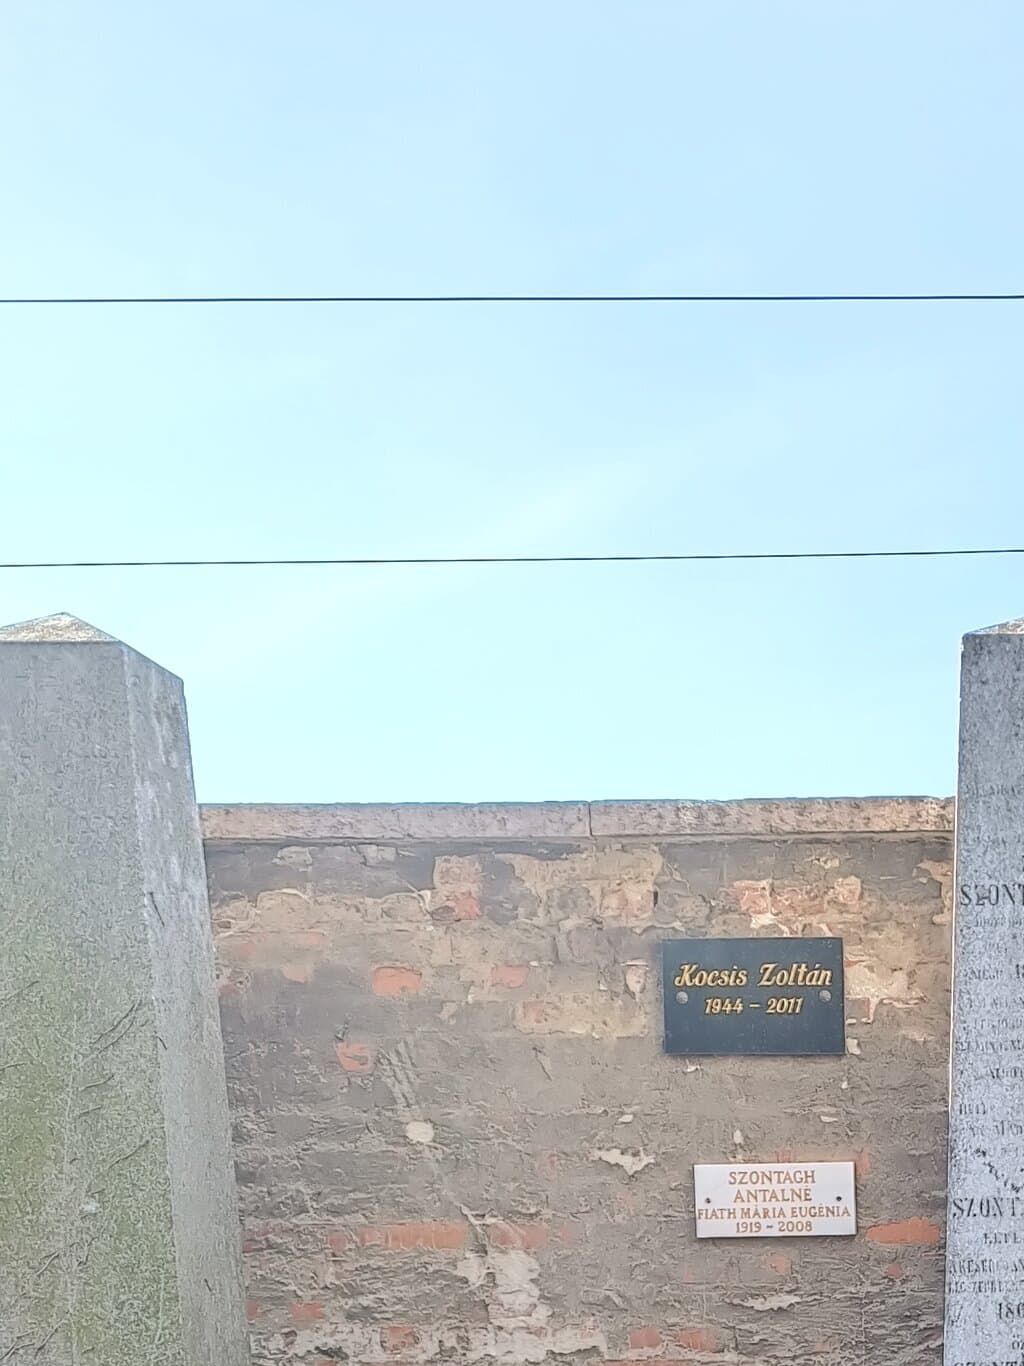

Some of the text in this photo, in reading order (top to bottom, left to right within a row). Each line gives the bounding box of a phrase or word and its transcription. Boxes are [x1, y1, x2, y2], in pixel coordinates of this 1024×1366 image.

[673, 962, 834, 987] Kocsis Zoltán
[704, 997, 744, 1015] 1944
[766, 997, 804, 1015] 2011
[728, 1170, 817, 1186] SZONTAGH
[733, 1186, 813, 1204] ANTALNÉ
[740, 1204, 788, 1220] MÁRIA
[790, 1203, 852, 1219] EUGÉNIA
[735, 1221, 763, 1234] 1919
[778, 1220, 813, 1233] 2008
